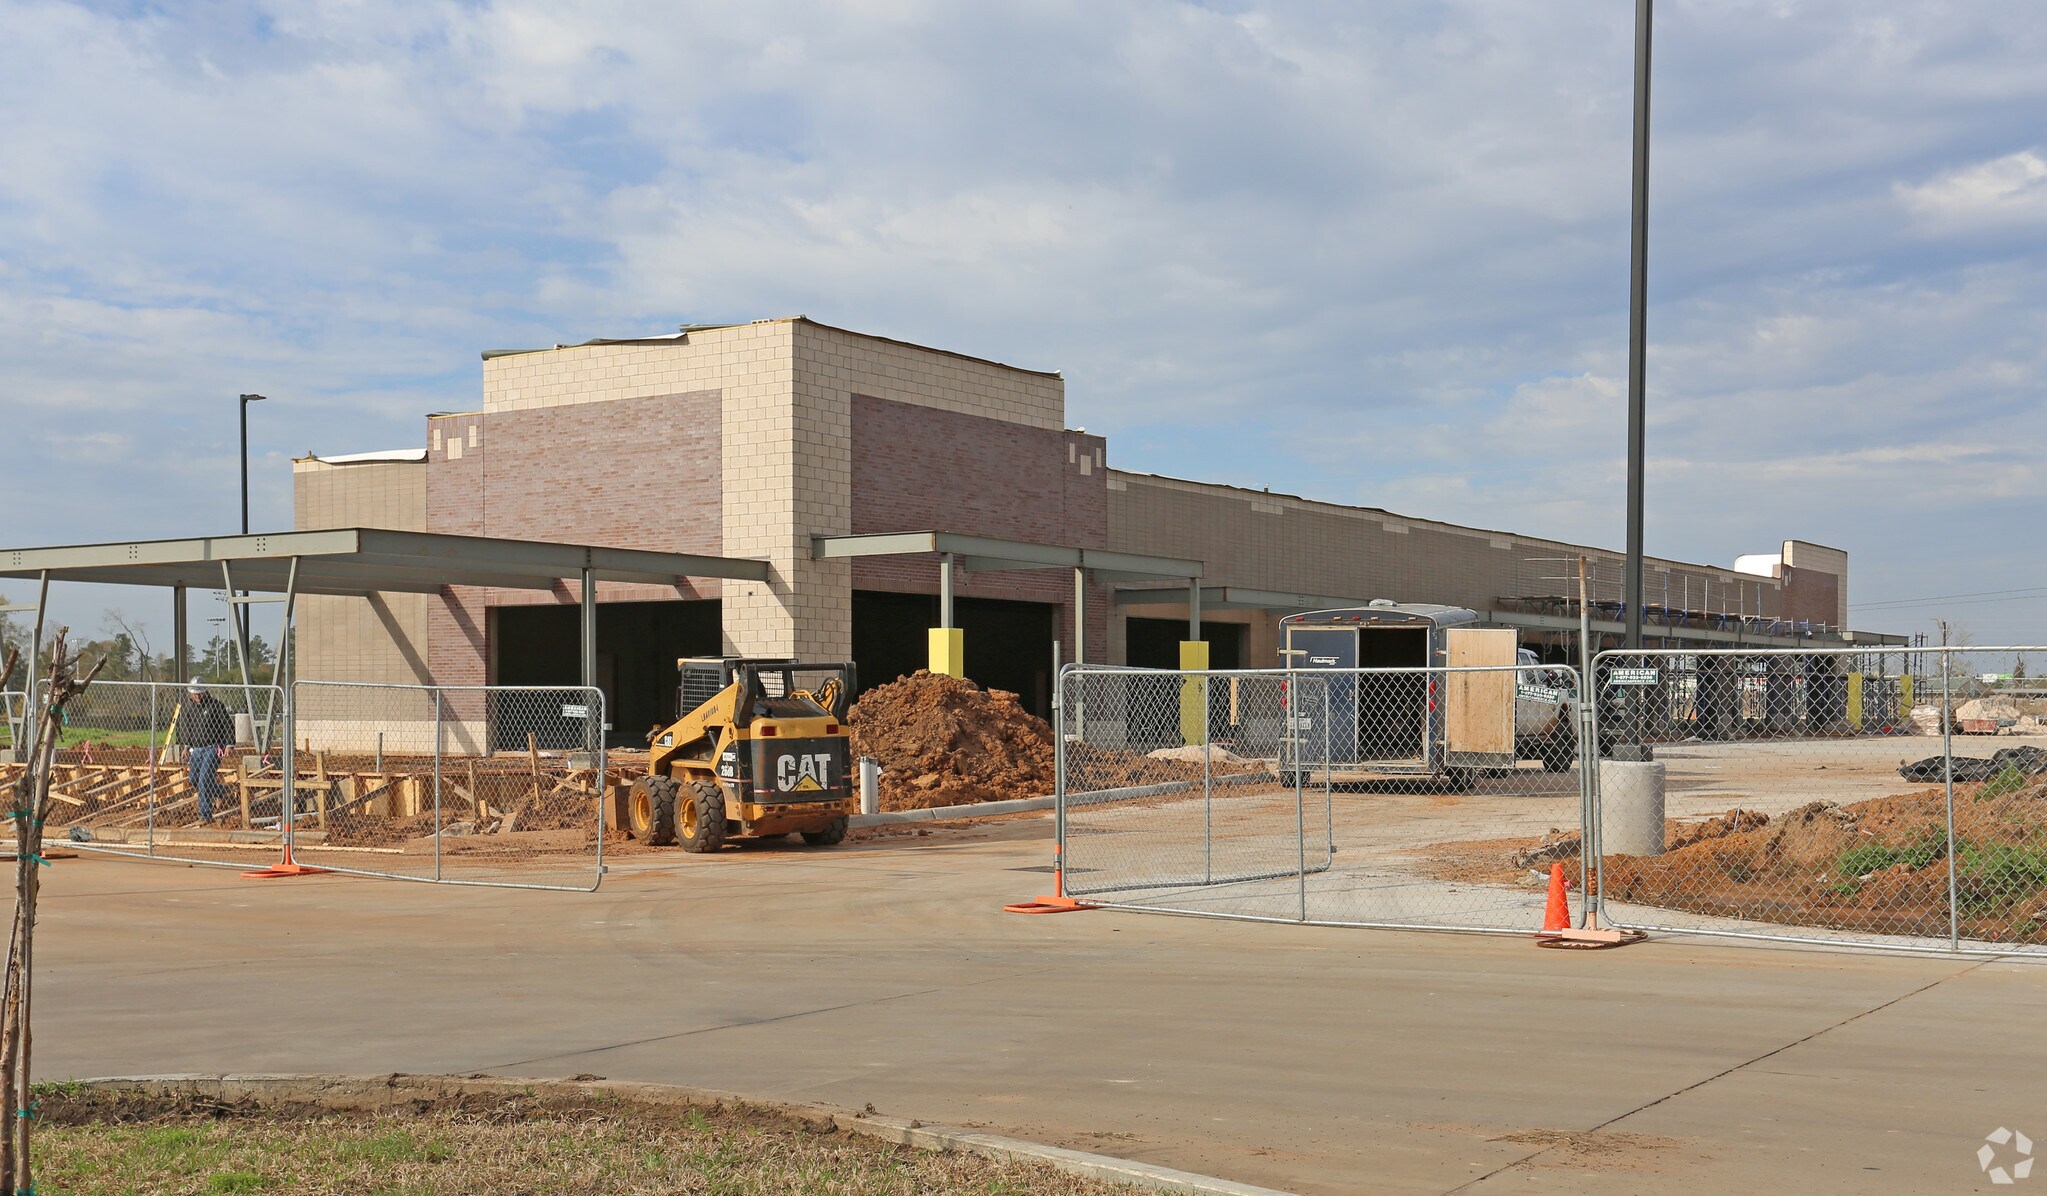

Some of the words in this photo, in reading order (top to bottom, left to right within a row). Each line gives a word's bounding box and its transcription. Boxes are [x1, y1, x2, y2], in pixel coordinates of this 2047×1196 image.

[1518, 685, 1558, 696] AMERICAN
[664, 735, 673, 746] CAT
[777, 753, 831, 792] CAT
